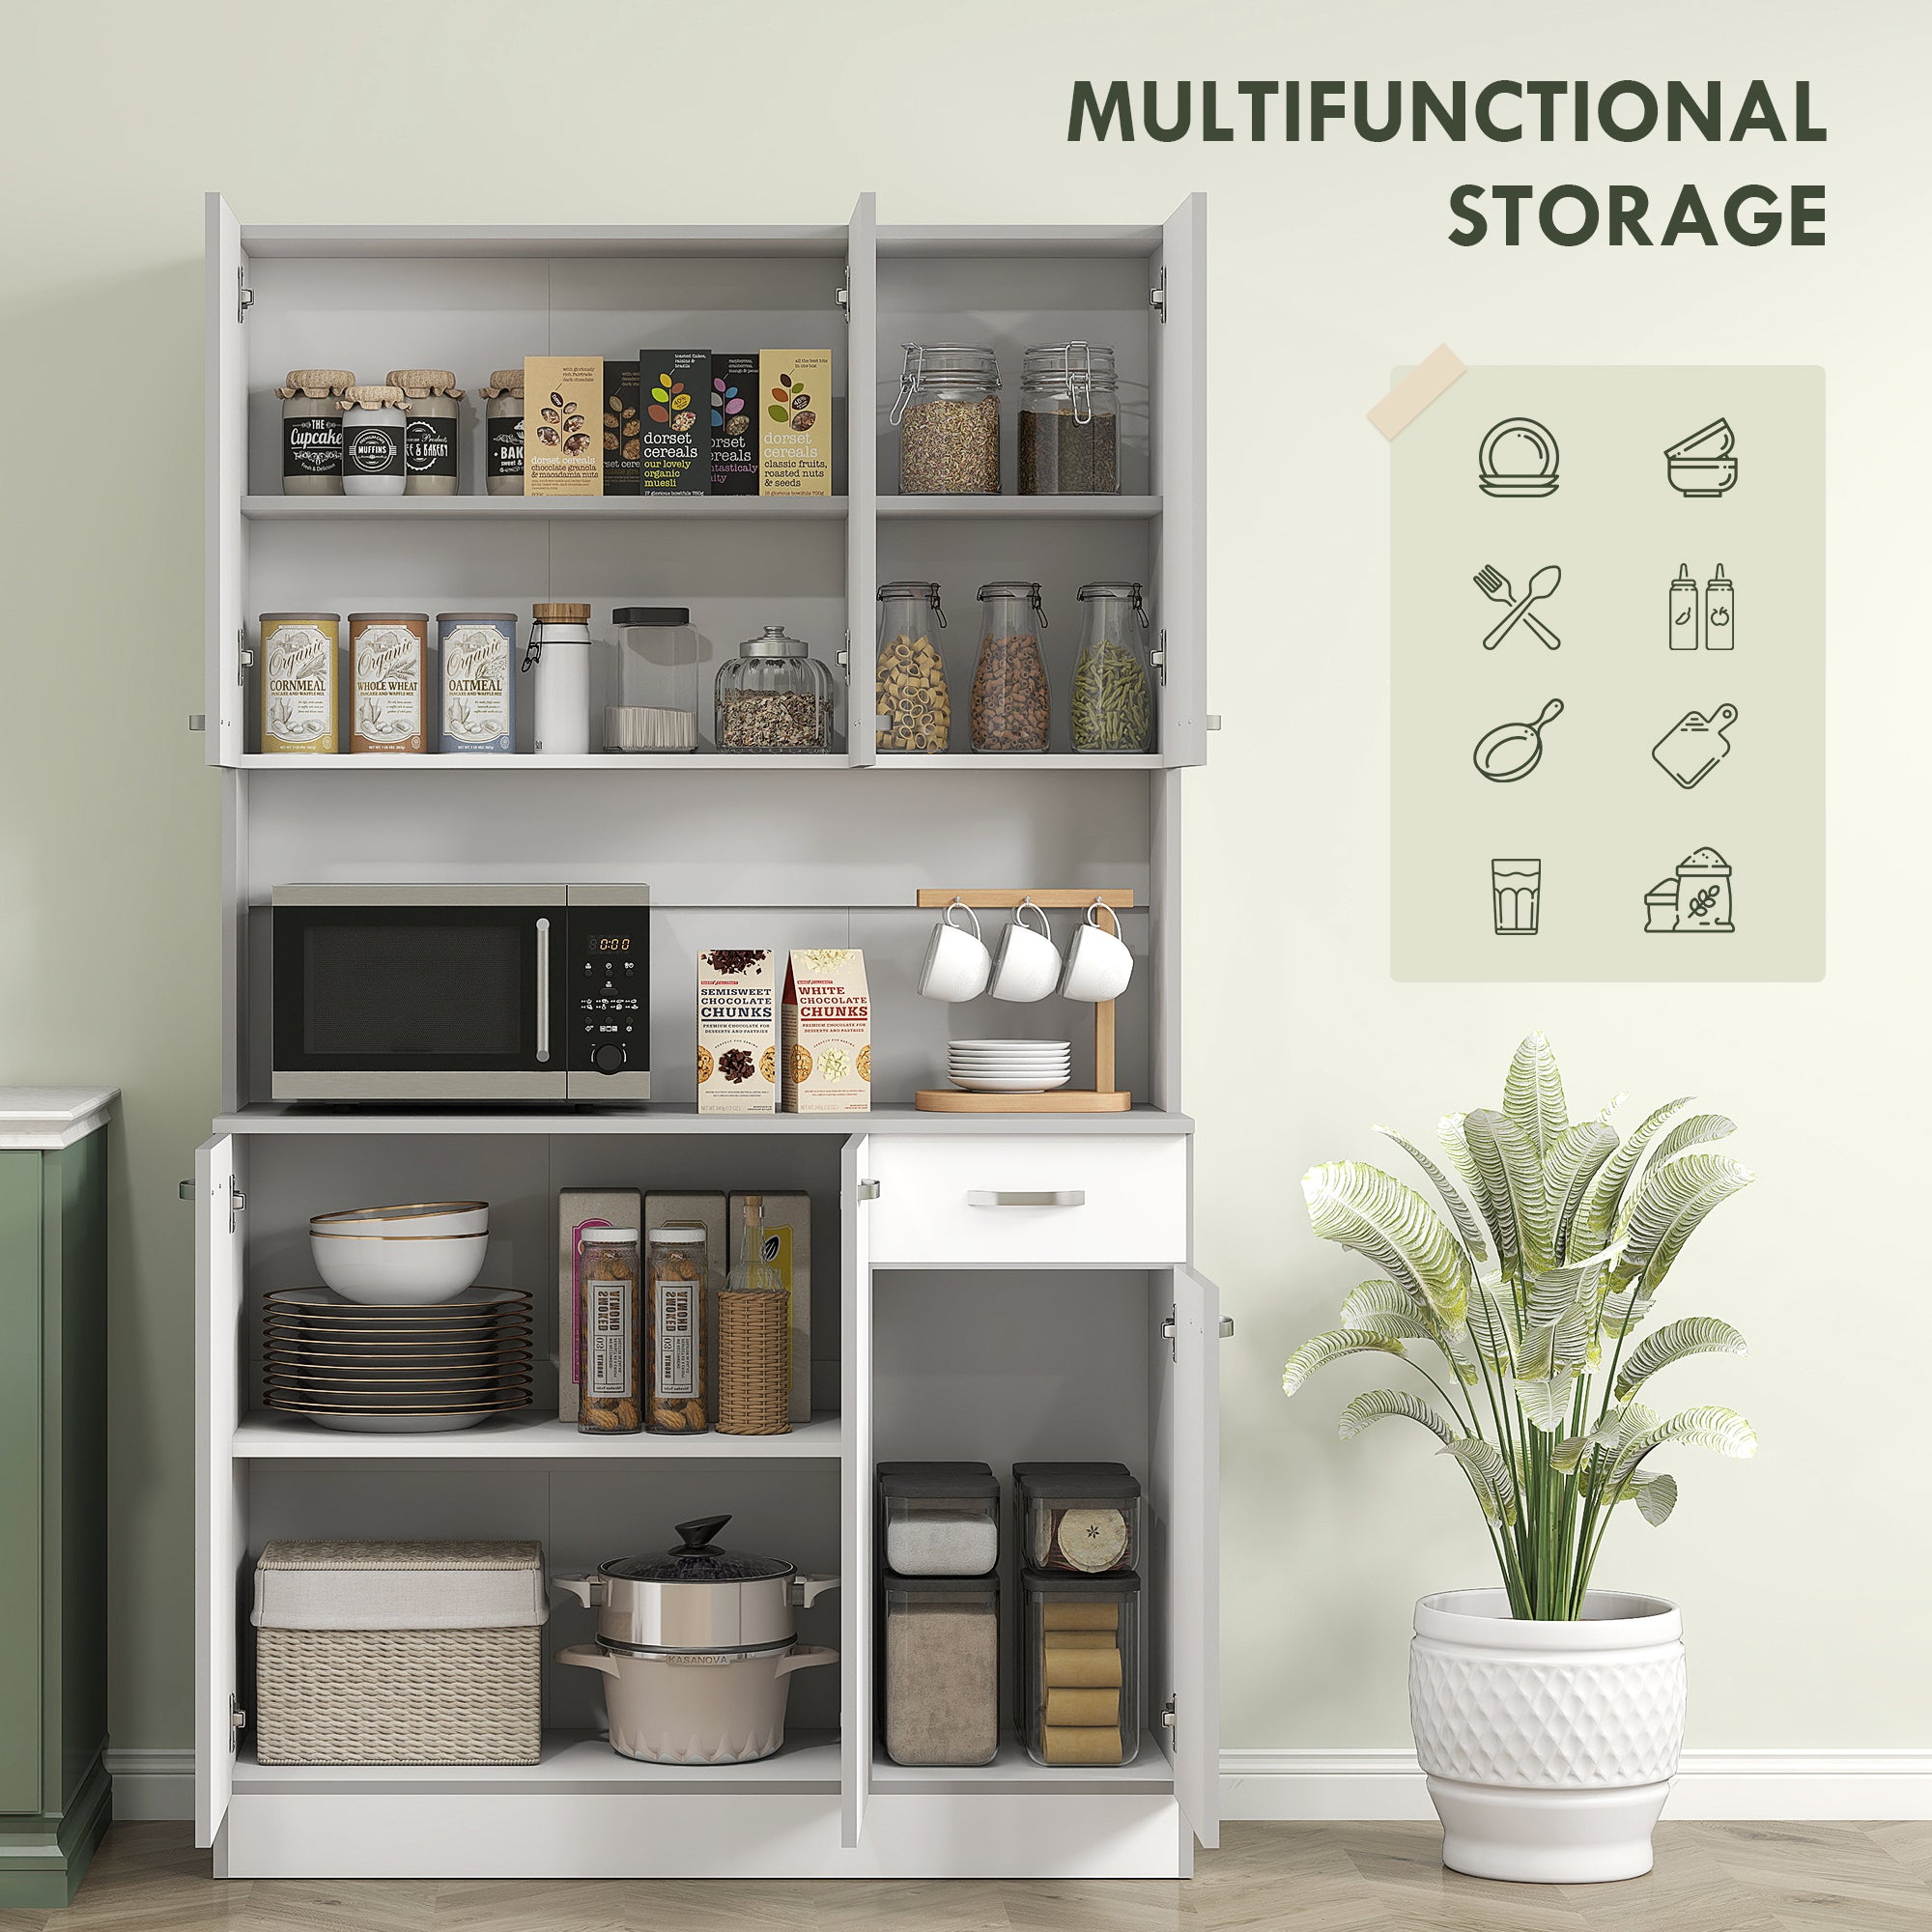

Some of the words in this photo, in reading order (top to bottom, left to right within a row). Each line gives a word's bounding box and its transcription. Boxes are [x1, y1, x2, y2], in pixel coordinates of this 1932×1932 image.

[311, 419, 325, 430] THE
[291, 428, 343, 450] Cupcake
[643, 432, 693, 444] dorset
[711, 436, 746, 448] orset
[764, 432, 812, 444] dorset
[358, 445, 386, 454] MUFFINS
[423, 443, 448, 457] BAKERY
[500, 446, 524, 460] BAK
[643, 445, 697, 458] cereals
[711, 449, 752, 461] reals
[764, 446, 817, 458] cereals
[301, 462, 312, 470] Fresh
[317, 463, 336, 471] Delicious
[663, 460, 692, 469] lovely
[711, 464, 758, 473] tasticaly
[799, 460, 828, 469] fruits,
[643, 469, 680, 479] organic
[764, 478, 774, 487] &
[269, 639, 323, 678] Organic
[358, 639, 412, 678] Organic
[447, 639, 500, 678] Organic
[270, 680, 326, 691] CORNMEAL
[357, 682, 386, 691] WHOLE
[388, 682, 417, 691] WHEAT
[448, 680, 502, 691] OATMEAL
[798, 986, 845, 995] WHITE
[701, 1008, 772, 1017] CHUNKS
[801, 1007, 867, 1016] CHUNKS
[668, 1656, 727, 1664] KASANOVA
